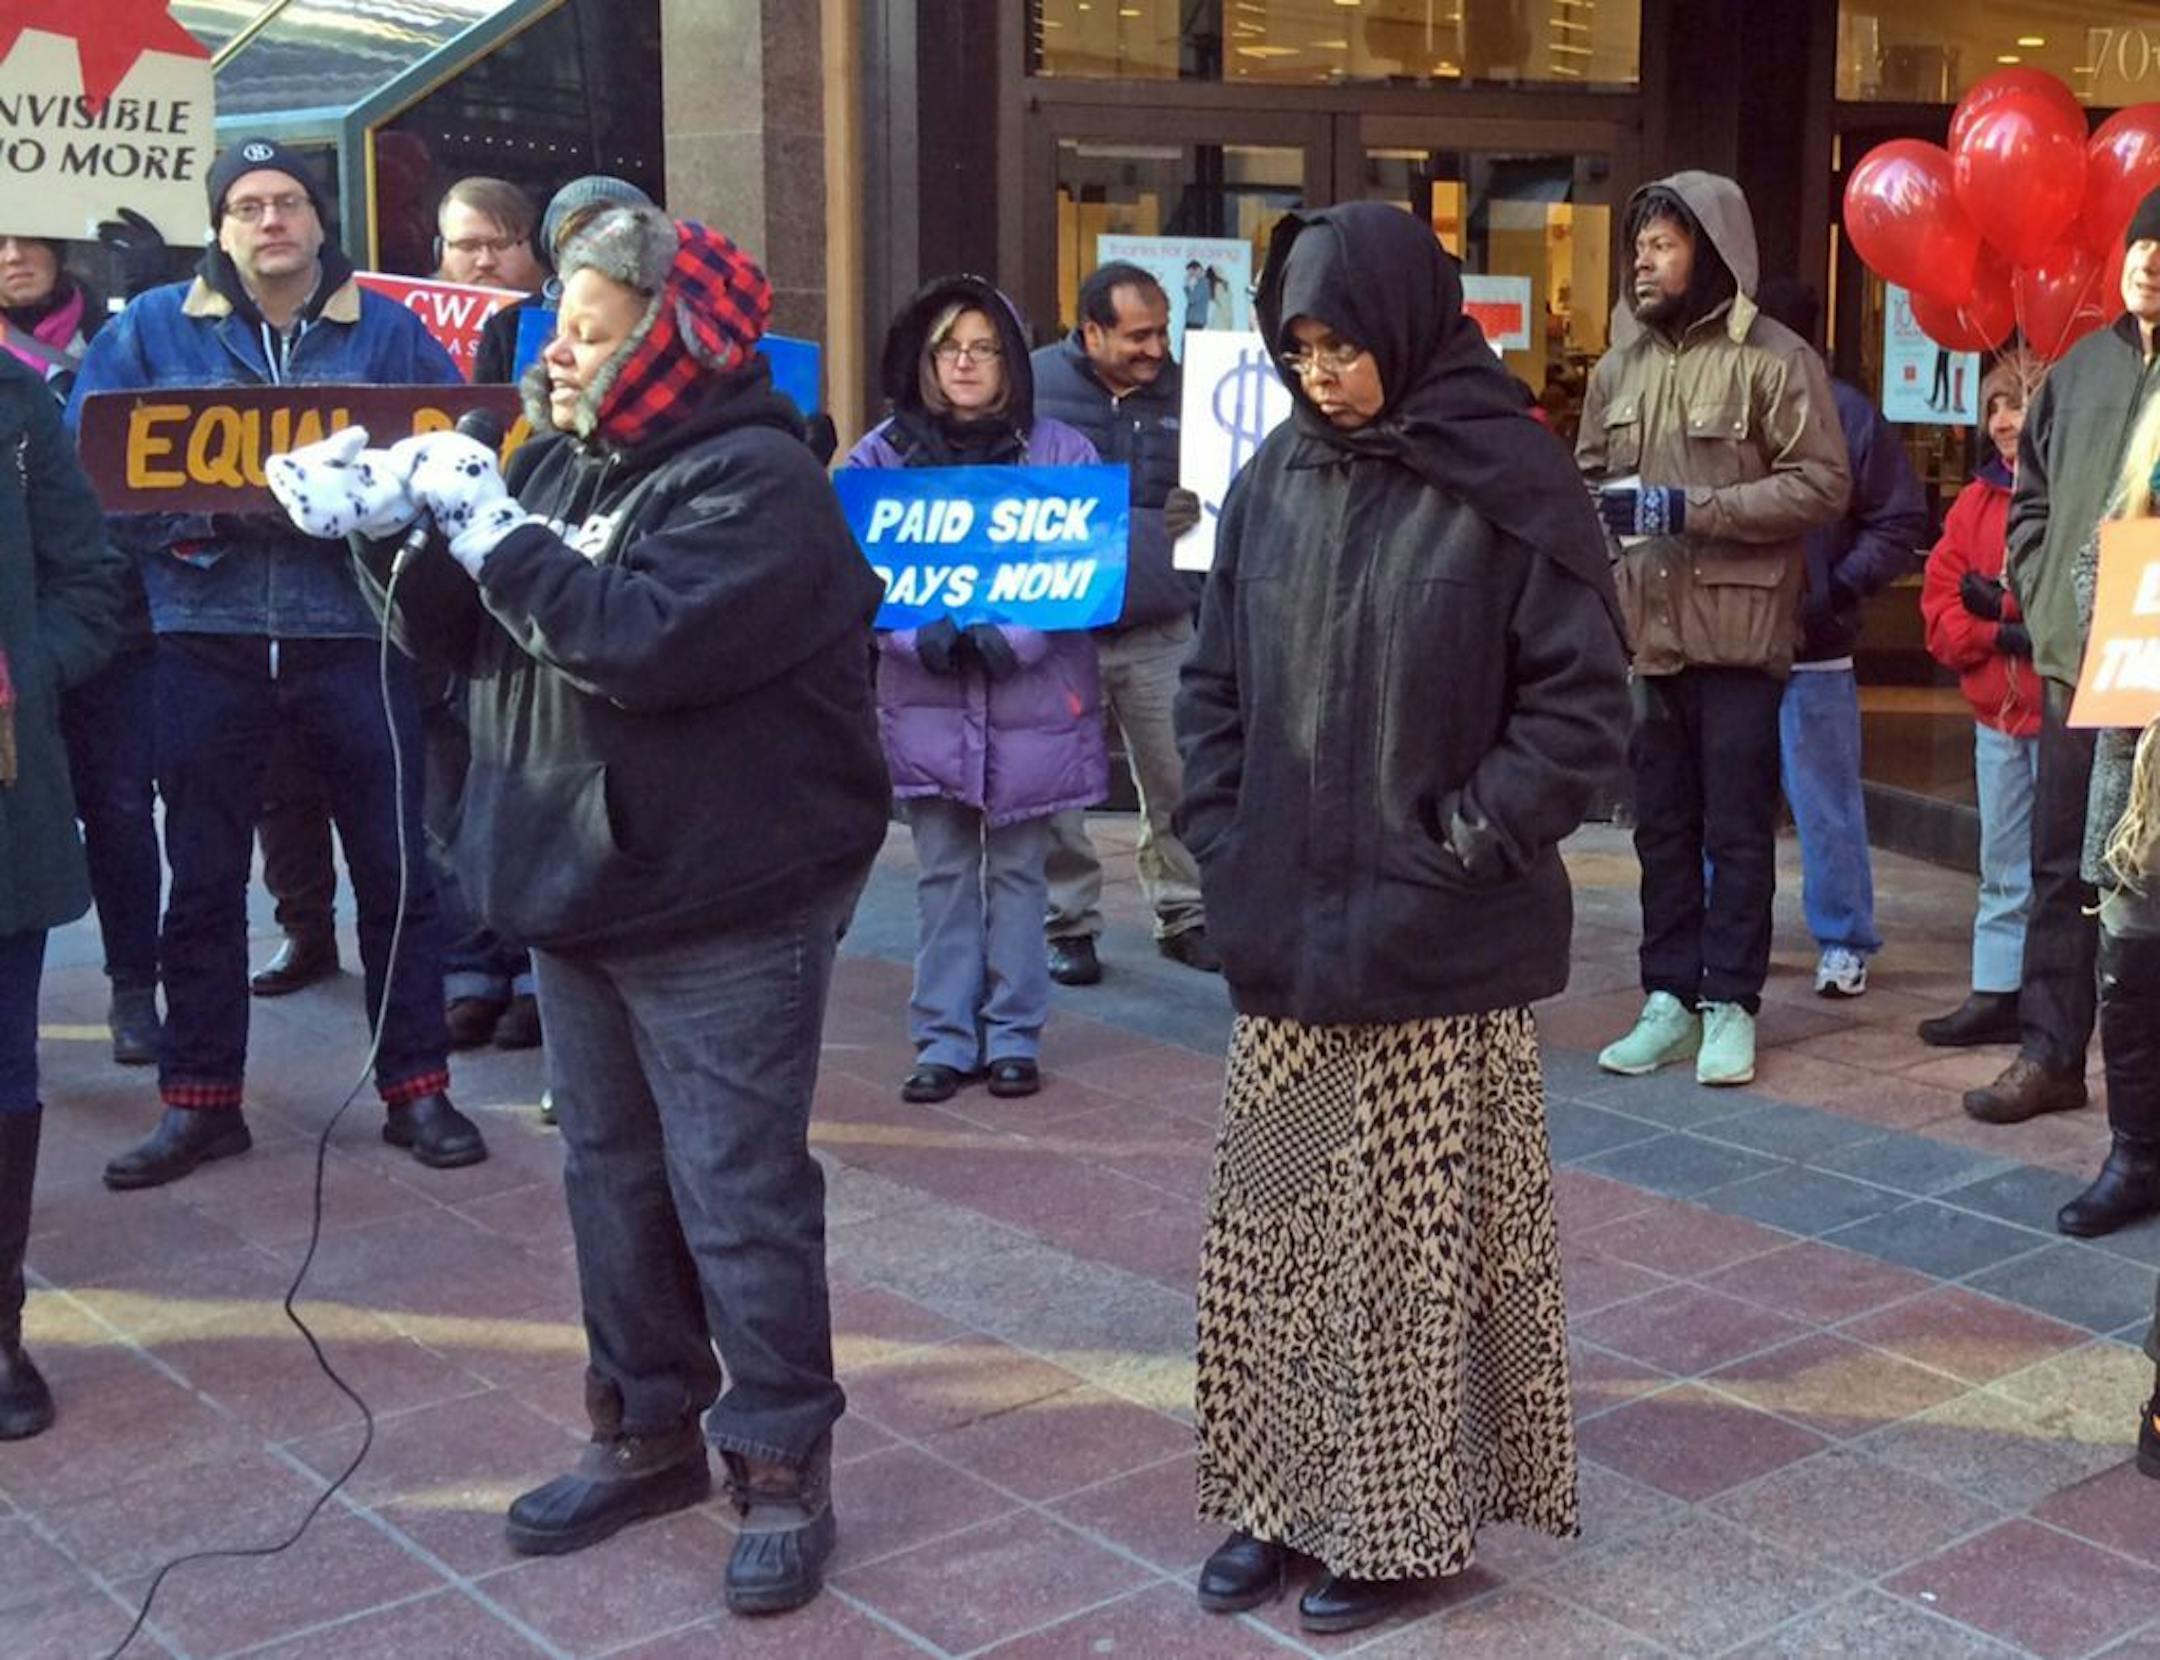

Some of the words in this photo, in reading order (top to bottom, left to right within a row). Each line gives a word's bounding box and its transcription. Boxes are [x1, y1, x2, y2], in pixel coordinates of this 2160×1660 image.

[2088, 27, 2160, 82] 70
[0, 138, 46, 173] O
[59, 142, 196, 180] MORE
[127, 404, 350, 489] EQU
[866, 499, 974, 543] PAID
[986, 497, 1098, 543] SICK
